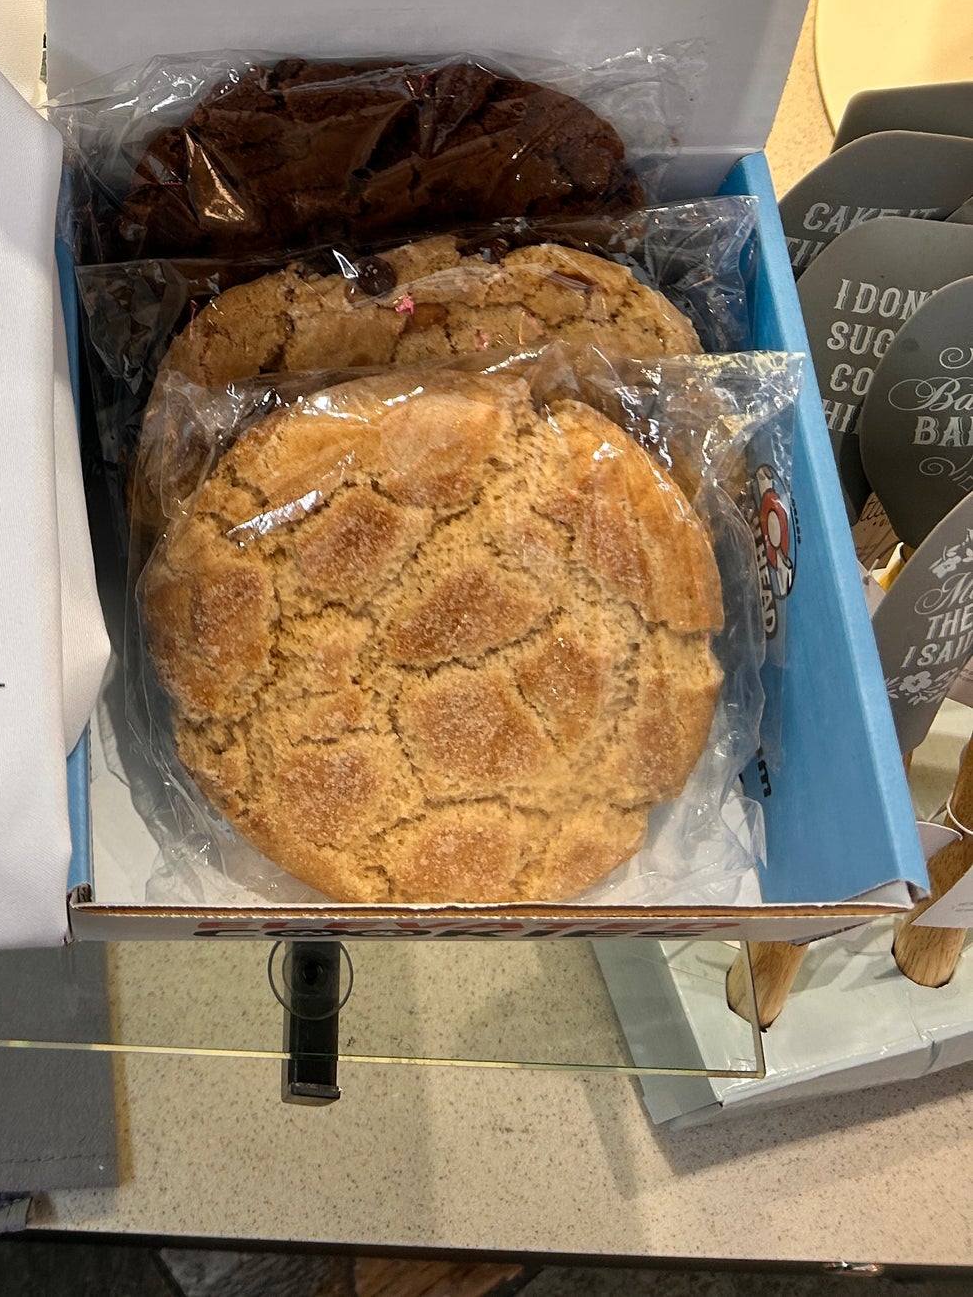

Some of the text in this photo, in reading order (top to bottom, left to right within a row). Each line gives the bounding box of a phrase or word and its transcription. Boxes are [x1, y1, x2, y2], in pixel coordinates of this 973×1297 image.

[834, 278, 939, 320] I DON
[827, 321, 895, 358] SUG
[900, 645, 918, 668] I
